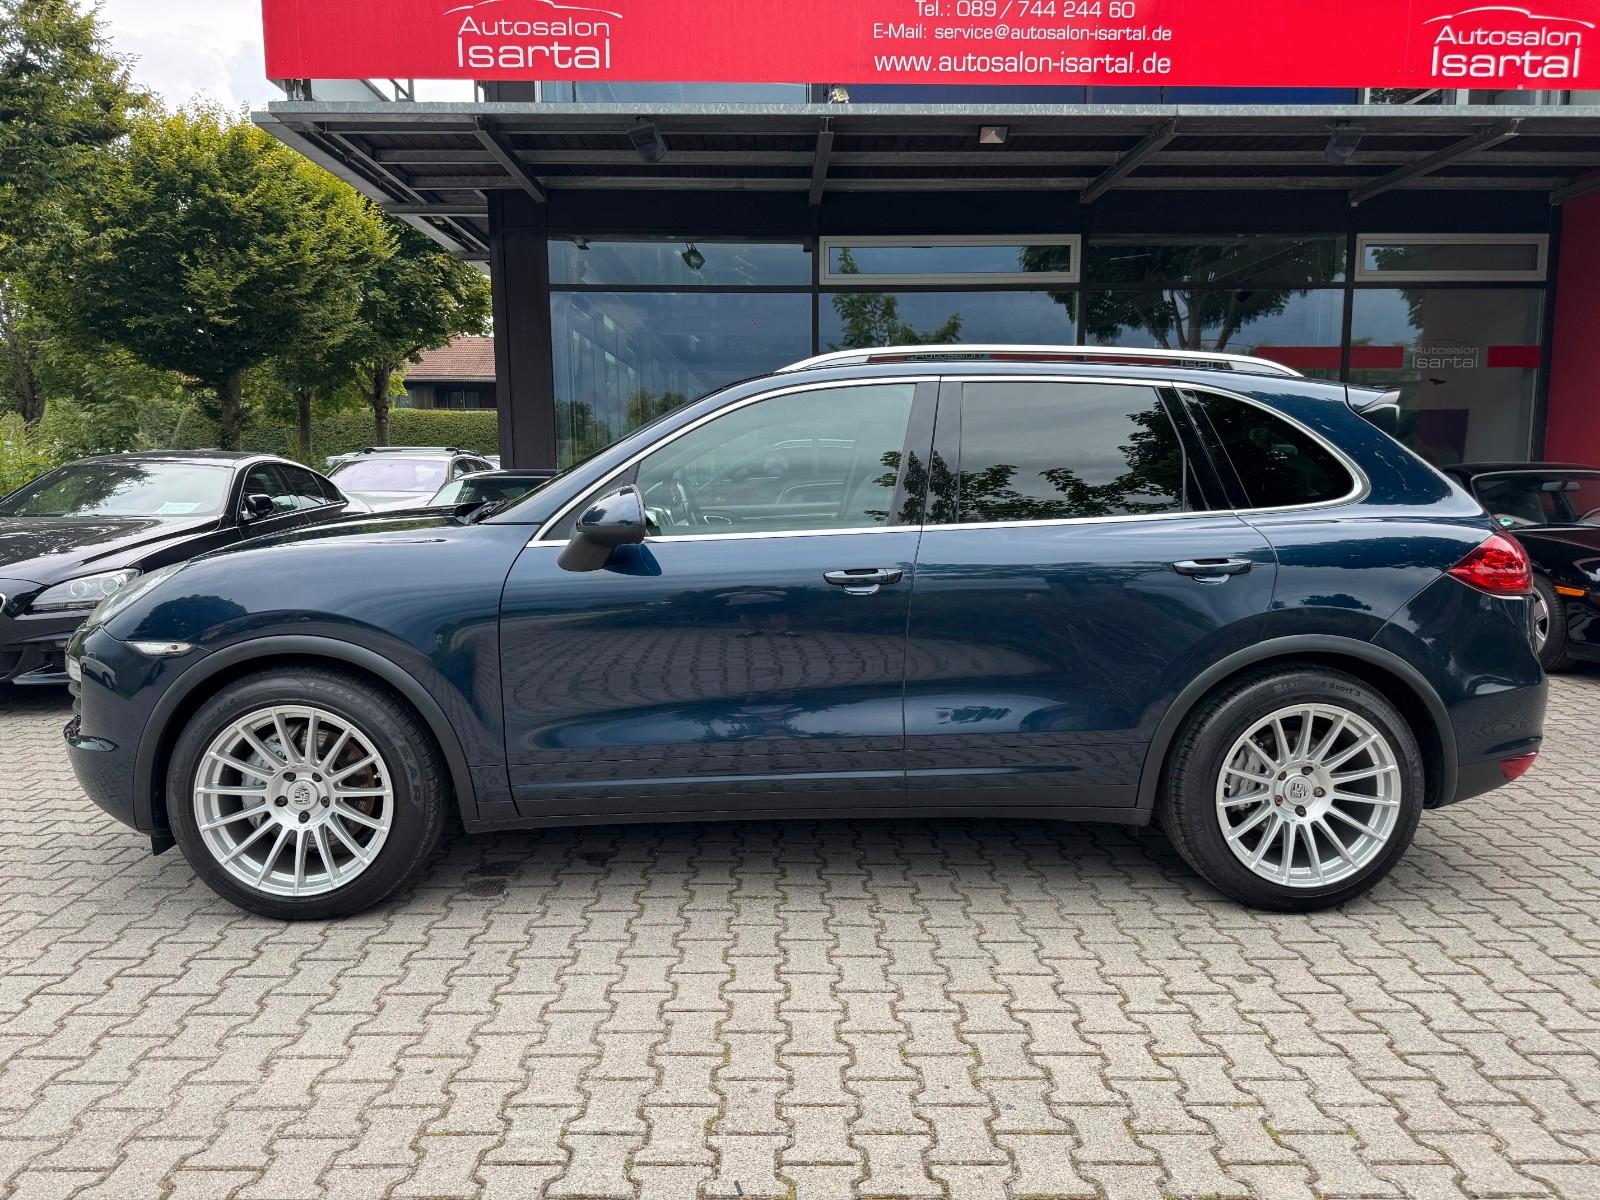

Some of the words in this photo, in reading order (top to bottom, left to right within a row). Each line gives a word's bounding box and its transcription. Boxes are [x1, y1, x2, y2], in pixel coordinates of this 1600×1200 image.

[915, 0, 951, 17] Tel.:
[956, 0, 997, 17] 089
[1018, 0, 1057, 17] 744
[1063, 1, 1102, 18] 244
[1109, 2, 1135, 18] 60
[457, 16, 610, 36] Autosalon
[873, 23, 927, 39] E-Mail:
[934, 23, 1172, 41] service@autosalon-isartal.de
[1434, 25, 1581, 46] Autosalon
[457, 37, 611, 69] Isartal
[874, 51, 1171, 74] www.autosalon-isartal.de
[1431, 45, 1581, 78] Isartal
[1413, 346, 1479, 355] Autosalon
[1412, 355, 1478, 368] Isartal
